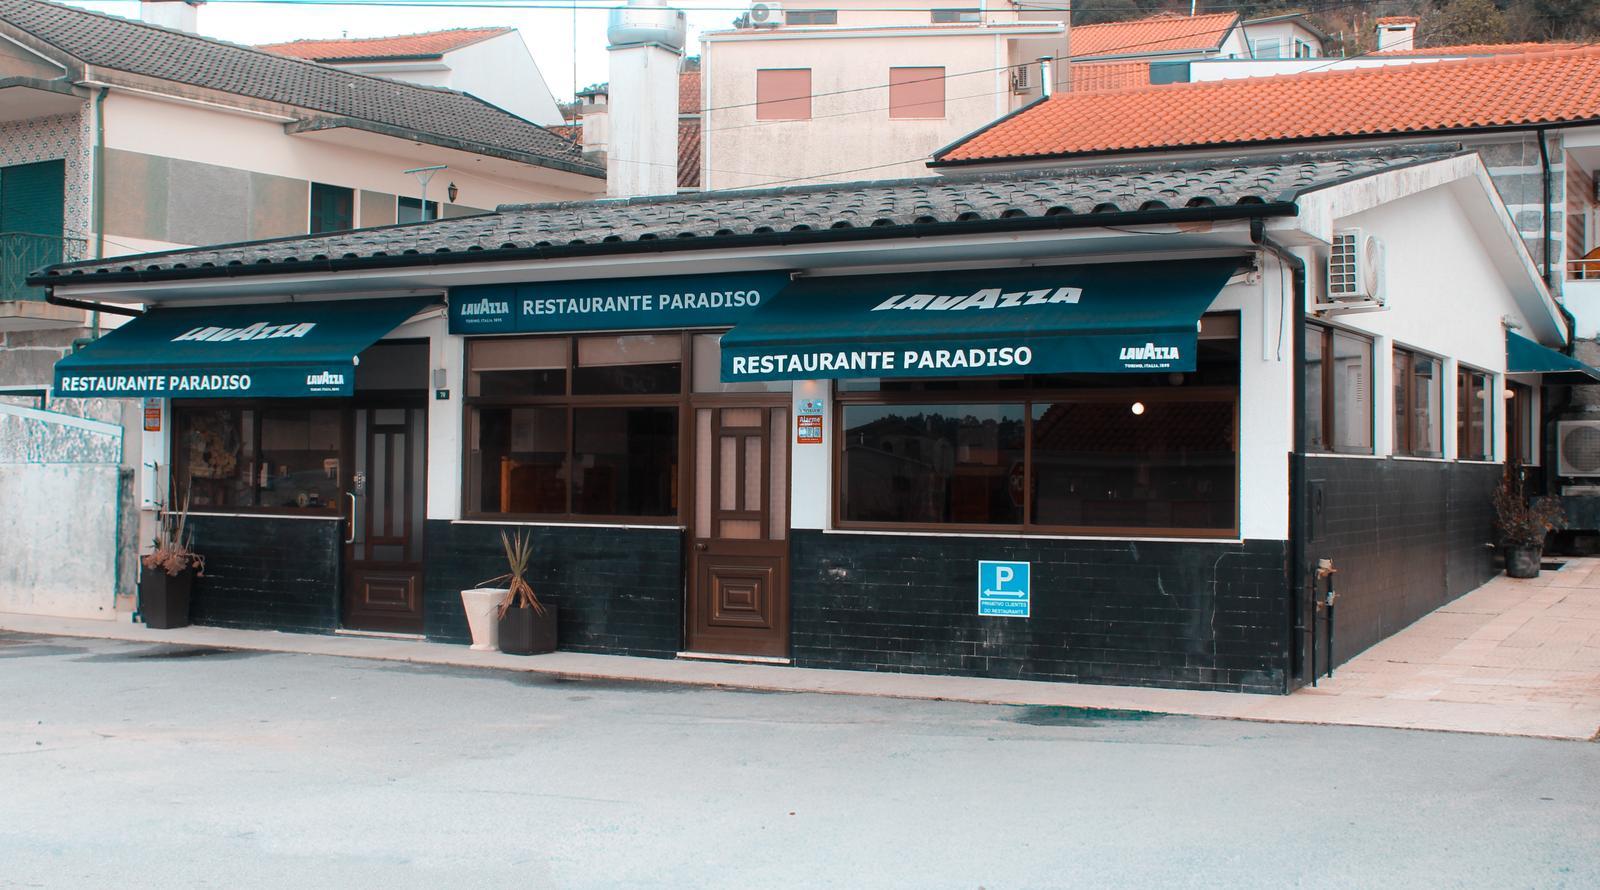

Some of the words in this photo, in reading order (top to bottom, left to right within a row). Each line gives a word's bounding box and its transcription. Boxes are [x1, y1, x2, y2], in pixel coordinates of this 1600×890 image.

[461, 299, 509, 316] LAVAZZA
[523, 295, 653, 315] RESTAURANTE
[658, 290, 761, 311] PARADISO
[871, 287, 1083, 312] LAVAZZA
[171, 322, 316, 342] LAVAZZA
[733, 351, 895, 375] RESTAURANTE
[903, 346, 1032, 370] PARADISO
[1119, 342, 1180, 360] LAVAZZA
[61, 376, 166, 392] RESTAURANTE
[169, 374, 252, 391] PARADISO
[306, 371, 345, 385] LAVAZZA
[996, 566, 1014, 591] P
